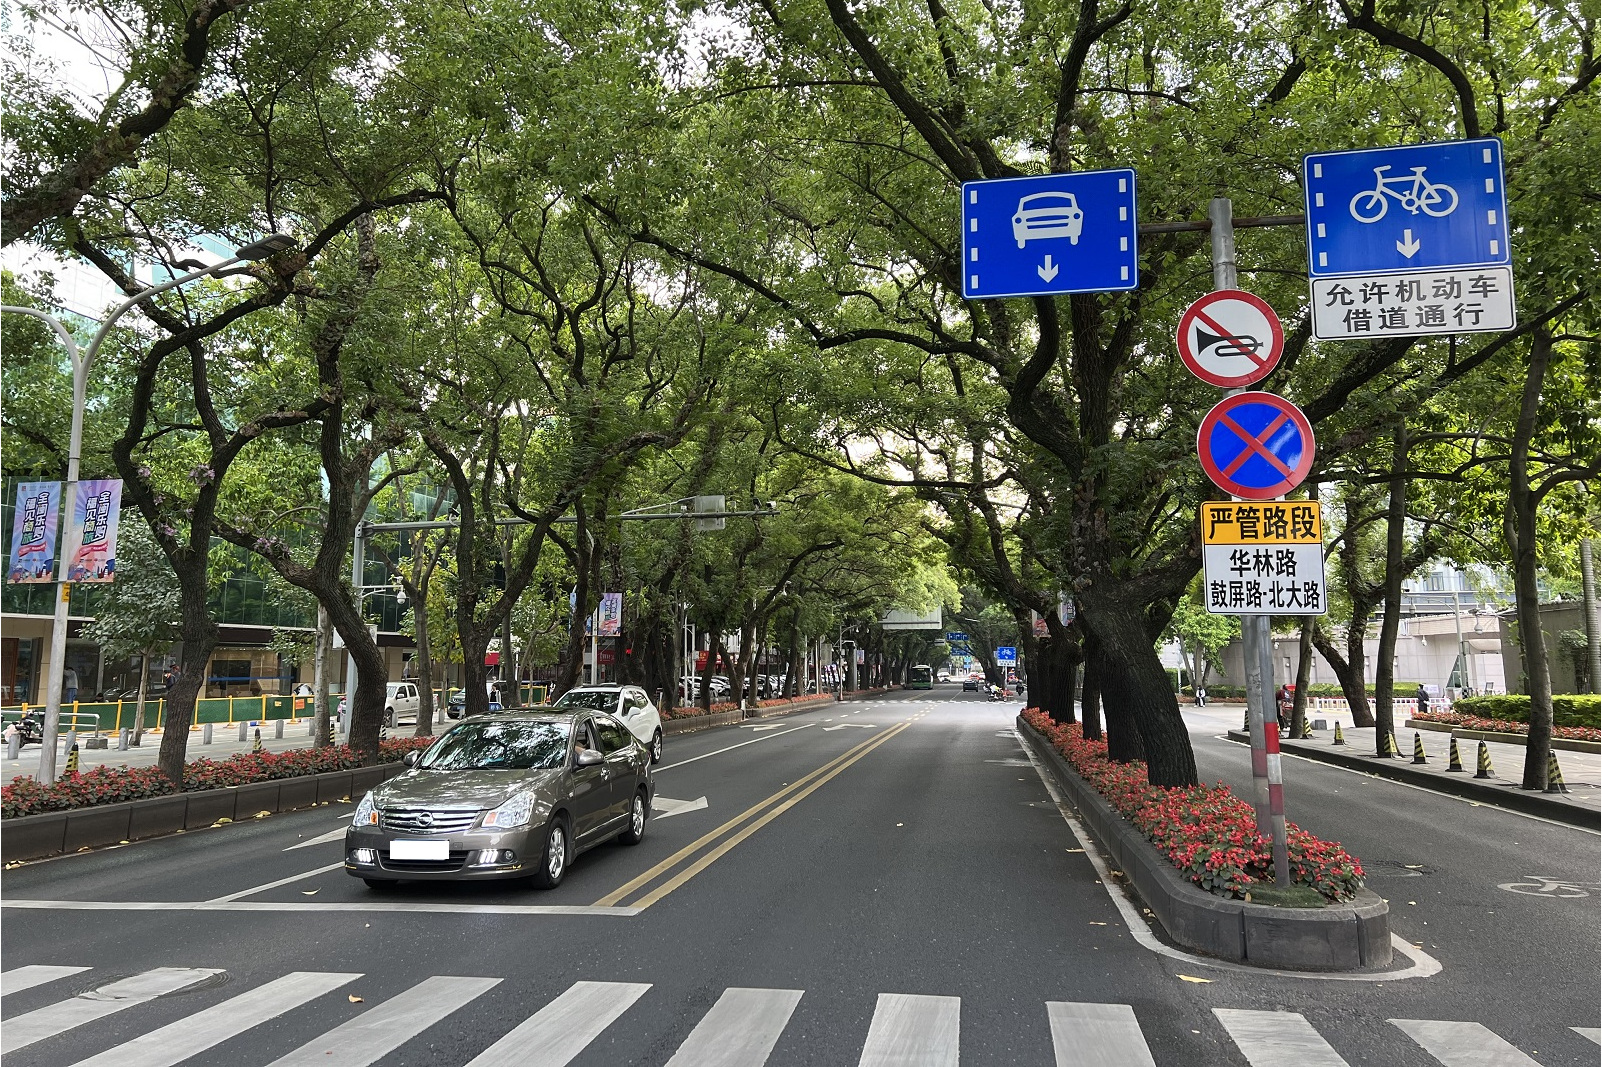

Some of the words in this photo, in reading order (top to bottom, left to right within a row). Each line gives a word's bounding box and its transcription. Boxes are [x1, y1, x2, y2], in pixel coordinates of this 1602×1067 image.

[1325, 275, 1499, 307] 允许机动车
[1343, 302, 1484, 333] 借道通行
[1209, 506, 1317, 540] 严管路段
[1229, 548, 1297, 577] 华林路
